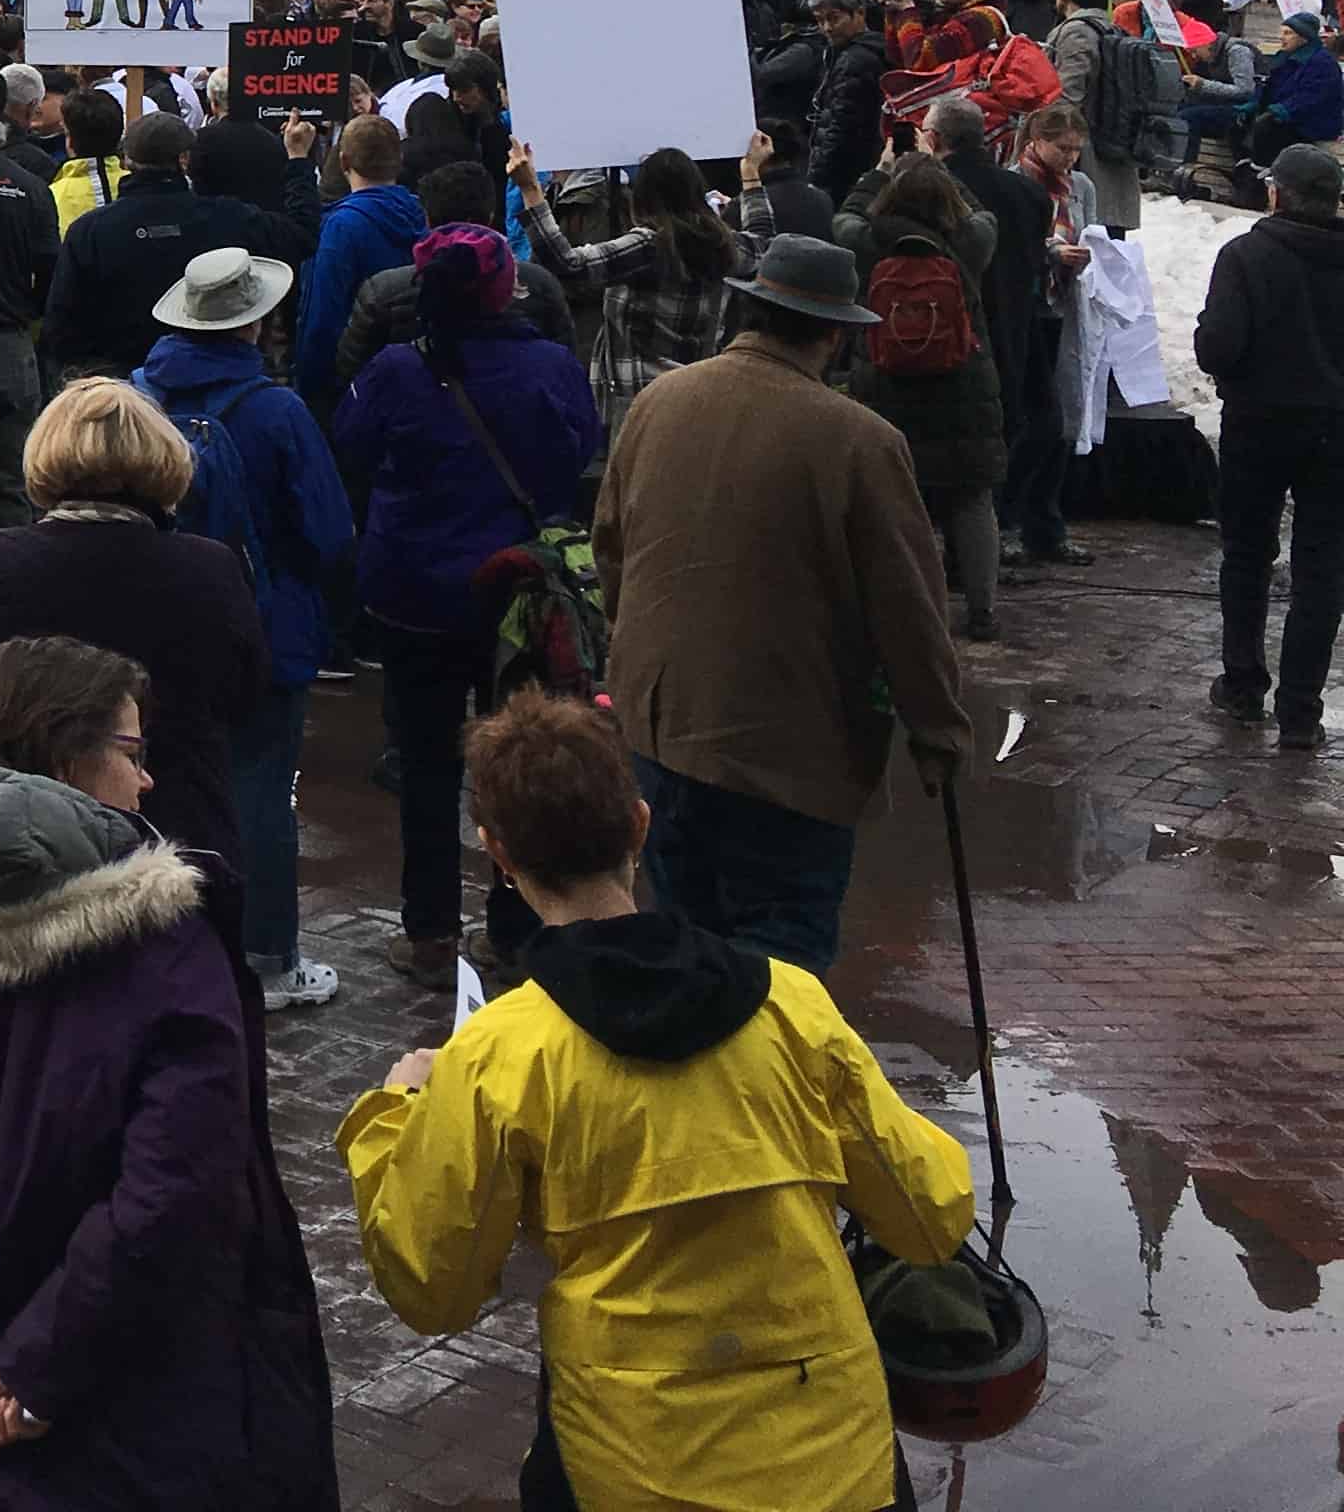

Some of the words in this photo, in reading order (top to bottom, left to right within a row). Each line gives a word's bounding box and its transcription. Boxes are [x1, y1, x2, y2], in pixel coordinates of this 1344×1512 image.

[243, 27, 312, 48] STAND
[315, 27, 341, 44] UP
[283, 50, 306, 71] for
[243, 72, 339, 96] SCIENCE
